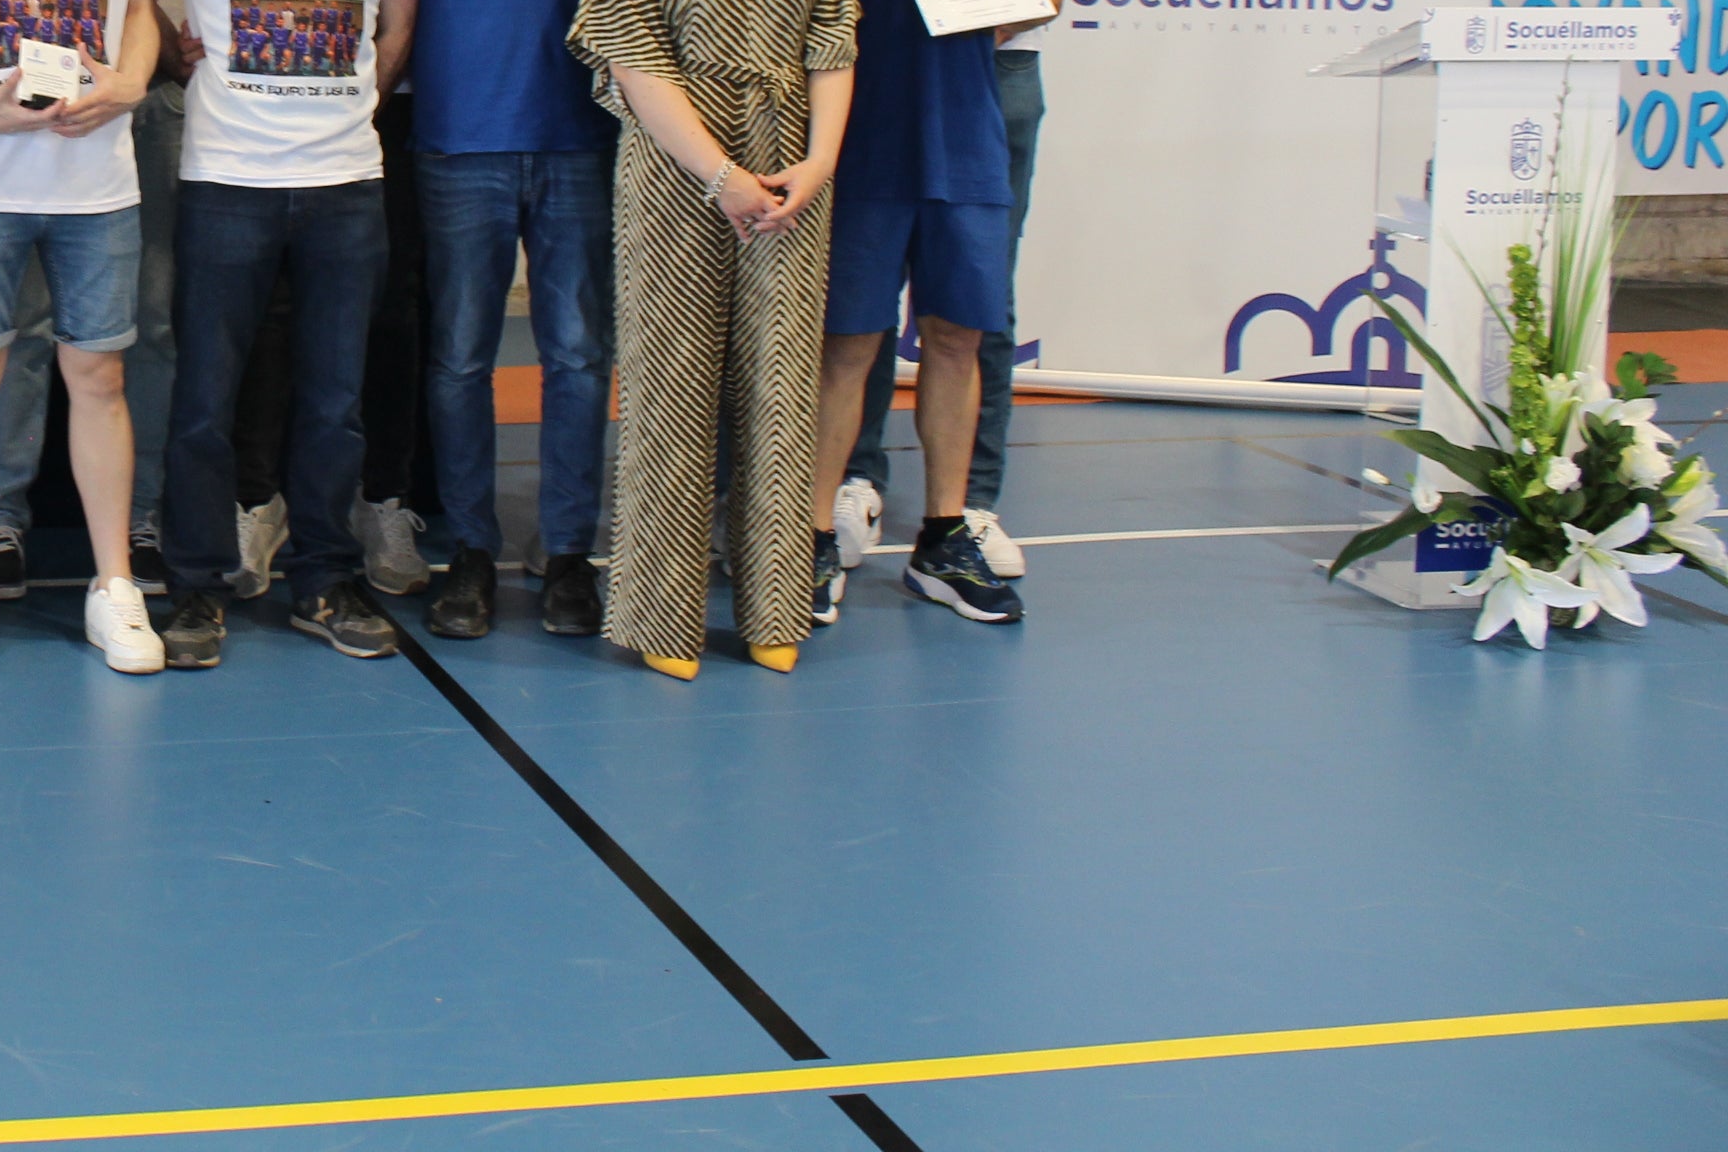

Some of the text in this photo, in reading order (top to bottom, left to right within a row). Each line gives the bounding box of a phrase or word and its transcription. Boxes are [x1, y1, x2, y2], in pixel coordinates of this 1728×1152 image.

[1107, 21, 1388, 36] AYUNTAMIENTO
[1506, 20, 1638, 40] Socuéllamos
[1465, 188, 1584, 205] Socuéllamos
